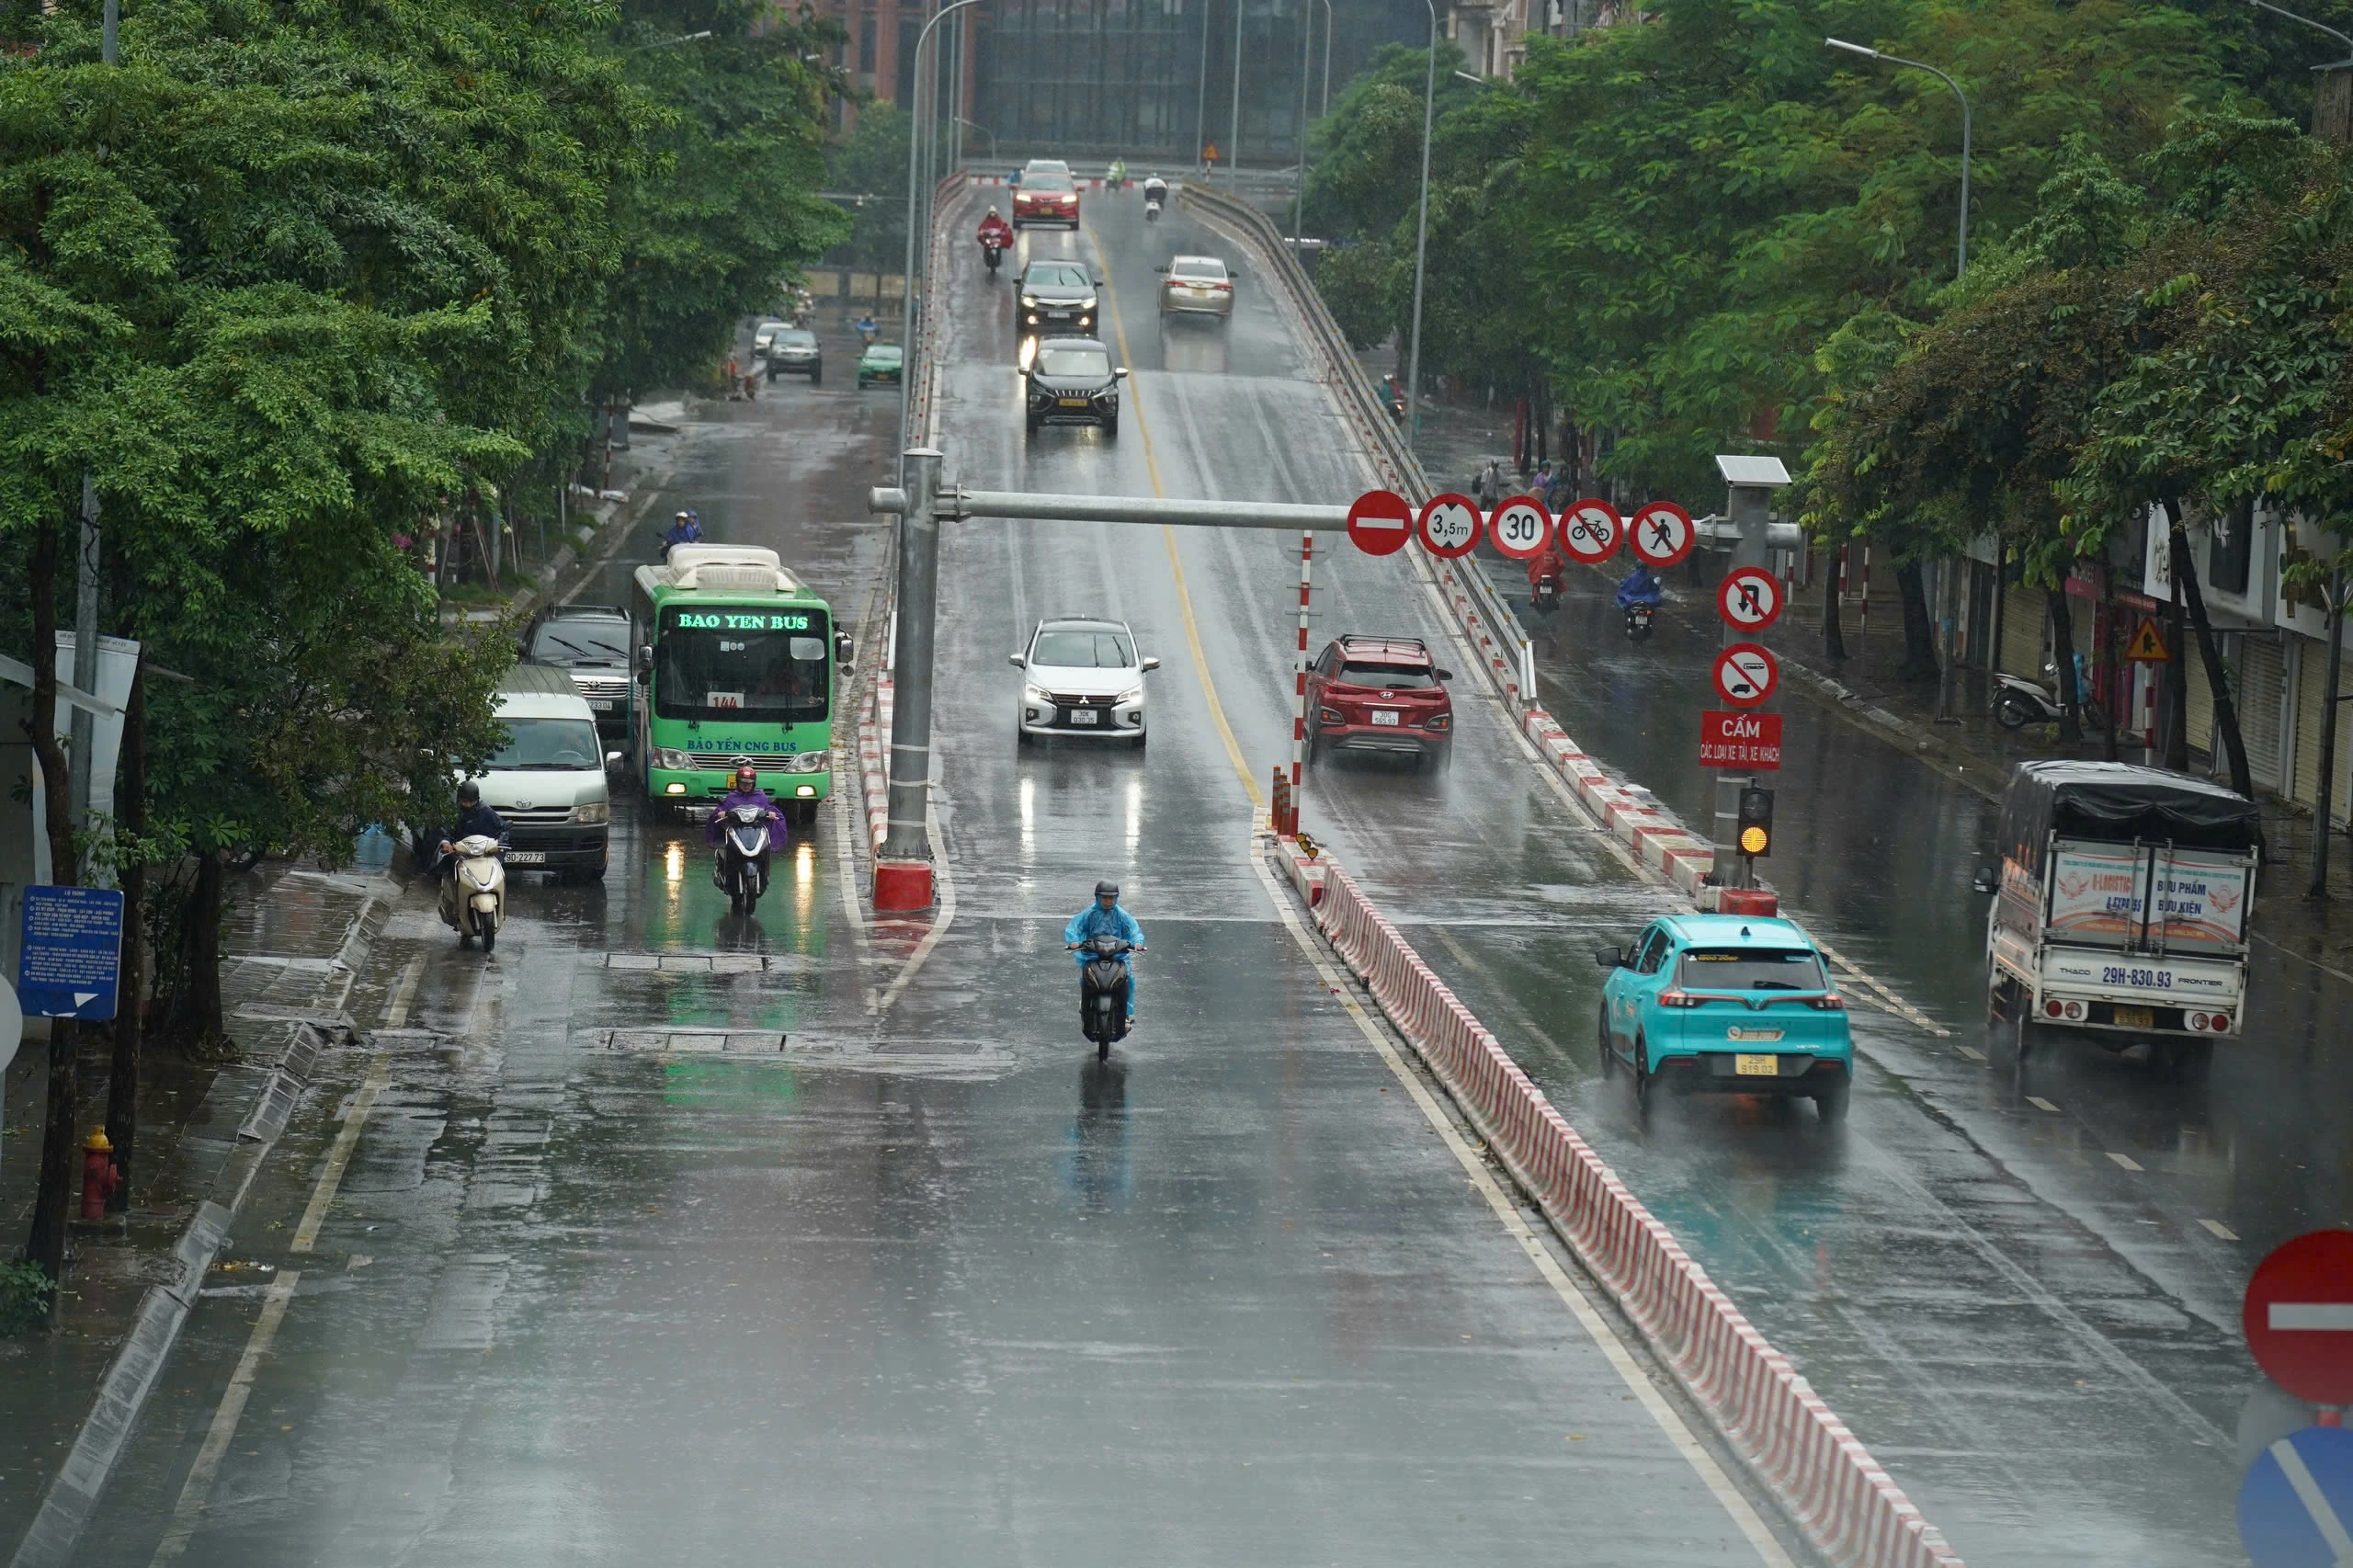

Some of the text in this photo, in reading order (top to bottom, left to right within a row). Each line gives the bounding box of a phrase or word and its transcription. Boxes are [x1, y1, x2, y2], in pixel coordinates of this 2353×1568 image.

[1433, 514, 1468, 537] 3,5m
[1506, 513, 1535, 540] 30
[678, 614, 809, 630] BAO YEN BUS
[712, 696, 738, 709] 144
[1722, 713, 1761, 738] CẤM
[687, 736, 797, 752] BẢO YẾN CNG BUS
[1700, 741, 1712, 759] CÁC
[1728, 745, 1736, 760] XE
[1750, 746, 1758, 761] XE
[1760, 743, 1780, 762] KHÁCH
[506, 853, 544, 862] 9D-227.73
[2059, 968, 2091, 976] THACO
[2103, 967, 2172, 988] 29H-830.93
[2177, 977, 2223, 986] FRONTIER
